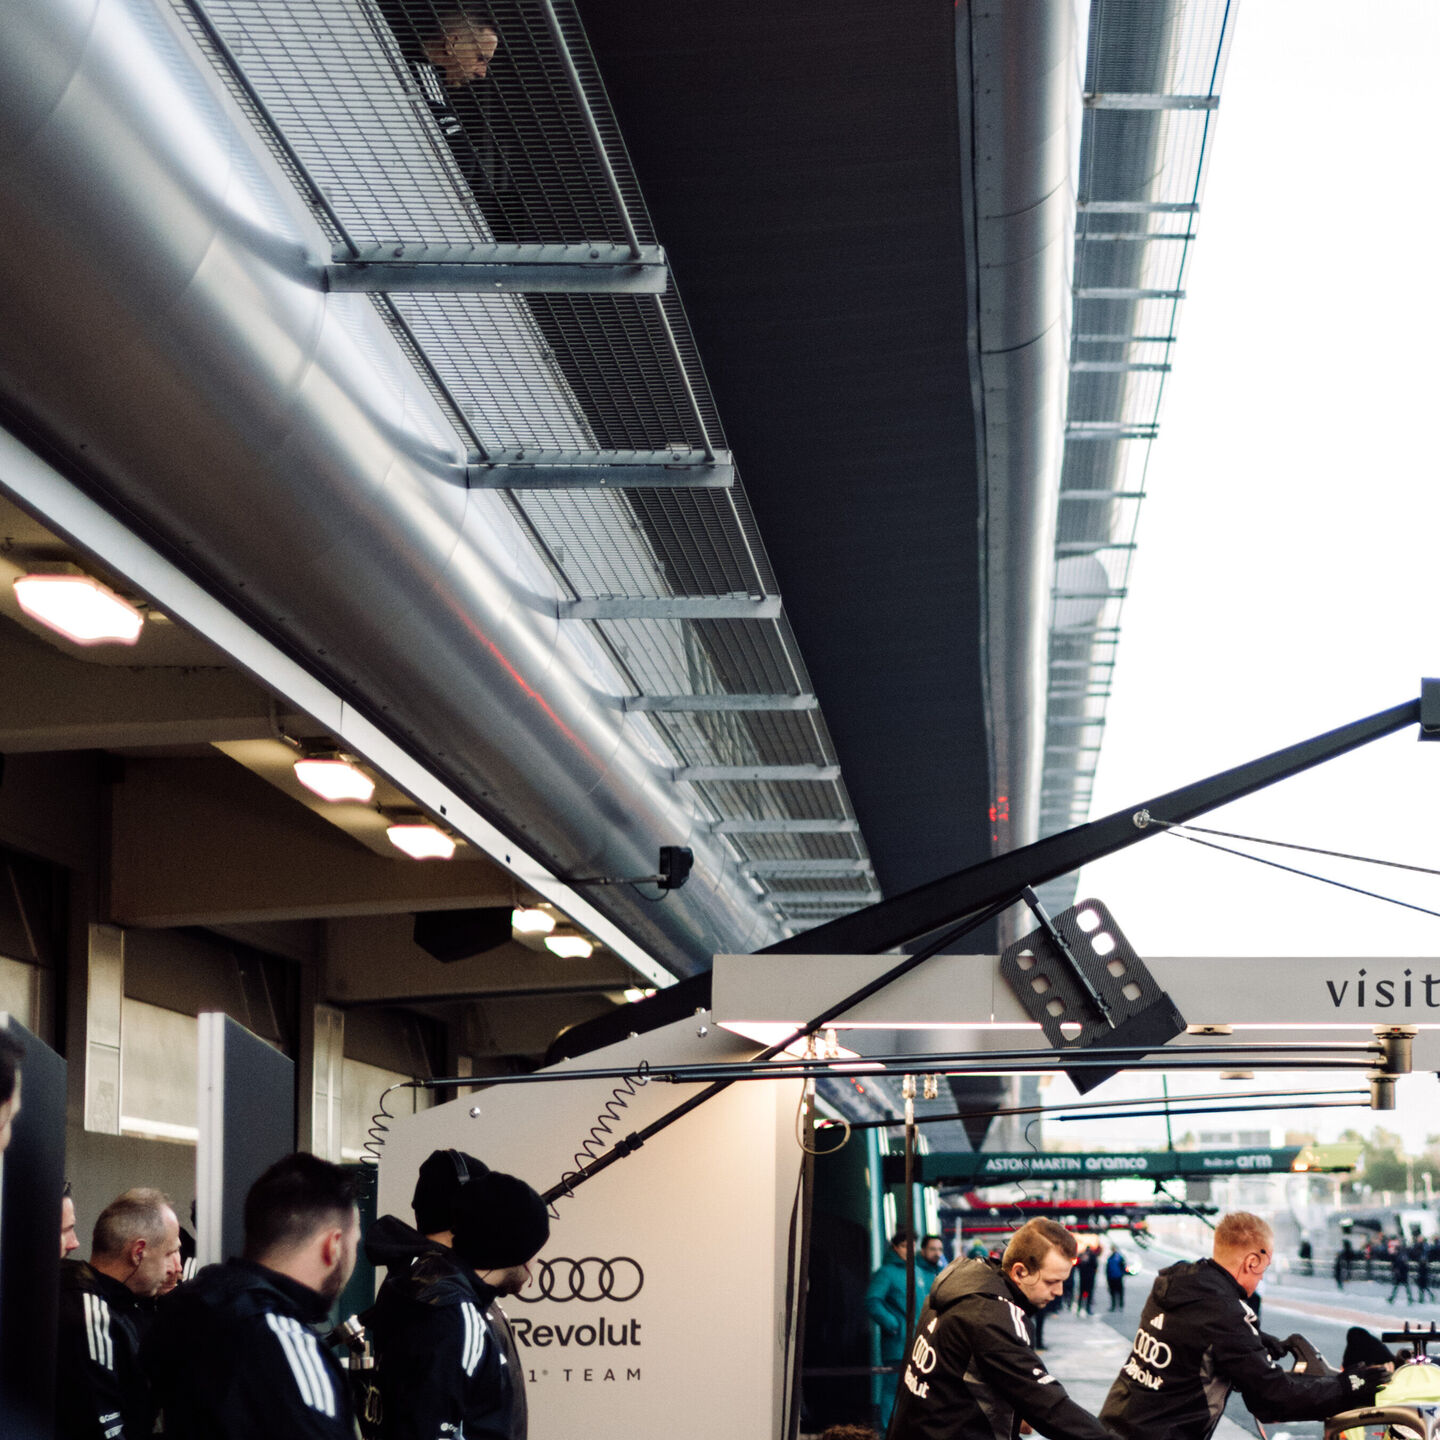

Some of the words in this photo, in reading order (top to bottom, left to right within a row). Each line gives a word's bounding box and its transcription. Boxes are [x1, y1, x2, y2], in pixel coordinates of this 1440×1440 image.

[985, 1158, 1029, 1171] ASTON
[1031, 1158, 1081, 1171] MARTIN
[1085, 1158, 1148, 1170] aramco
[1236, 1155, 1273, 1169] arm
[510, 1316, 642, 1348] Revolut
[562, 1367, 642, 1383] TEAM
